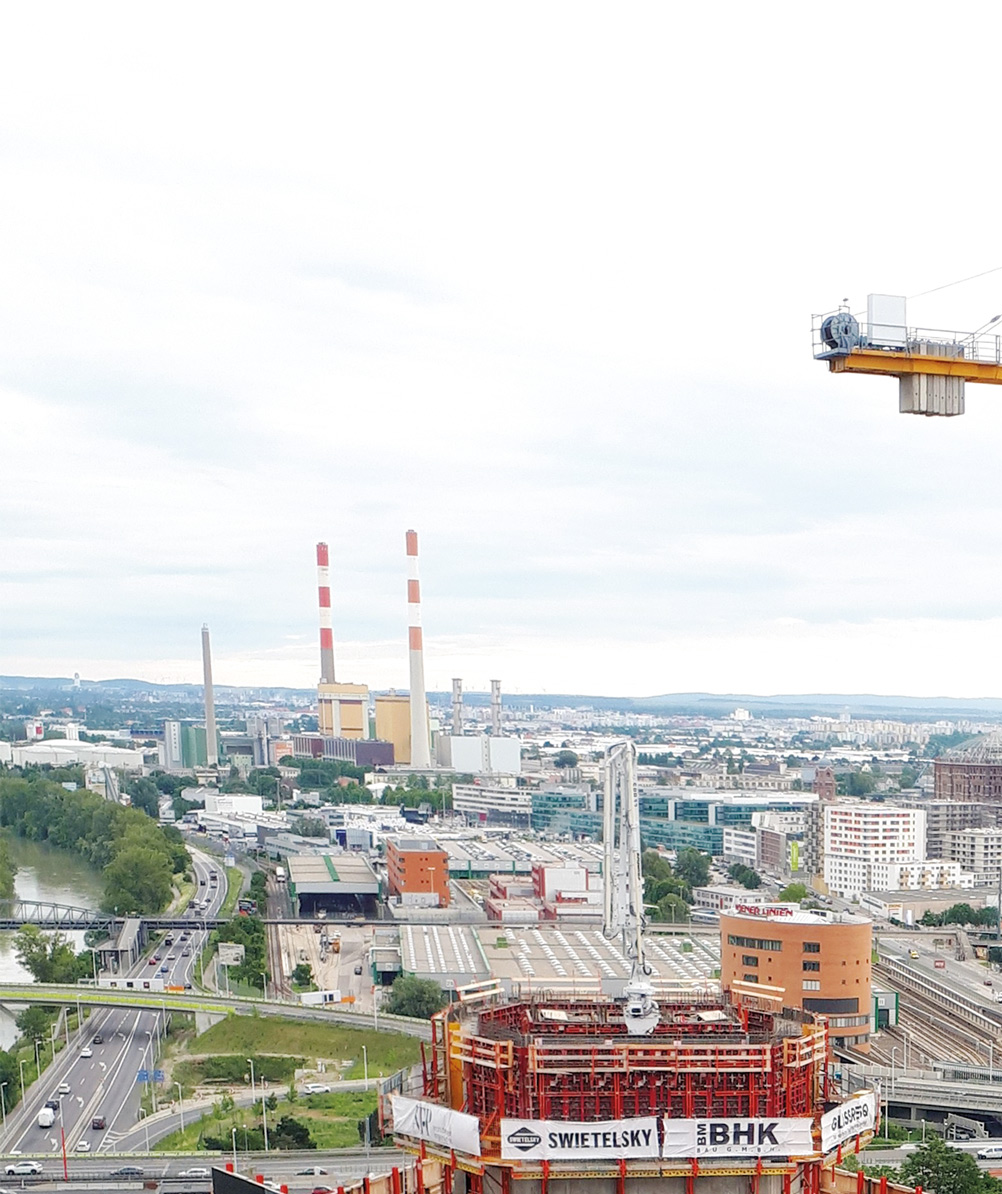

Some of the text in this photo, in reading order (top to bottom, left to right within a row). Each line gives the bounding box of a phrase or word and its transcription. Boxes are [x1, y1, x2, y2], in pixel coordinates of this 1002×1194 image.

[762, 907, 793, 917] LINIEN
[548, 1128, 652, 1149] SWIETELSKY
[696, 1123, 707, 1146] BM
[709, 1122, 779, 1146] BHK
